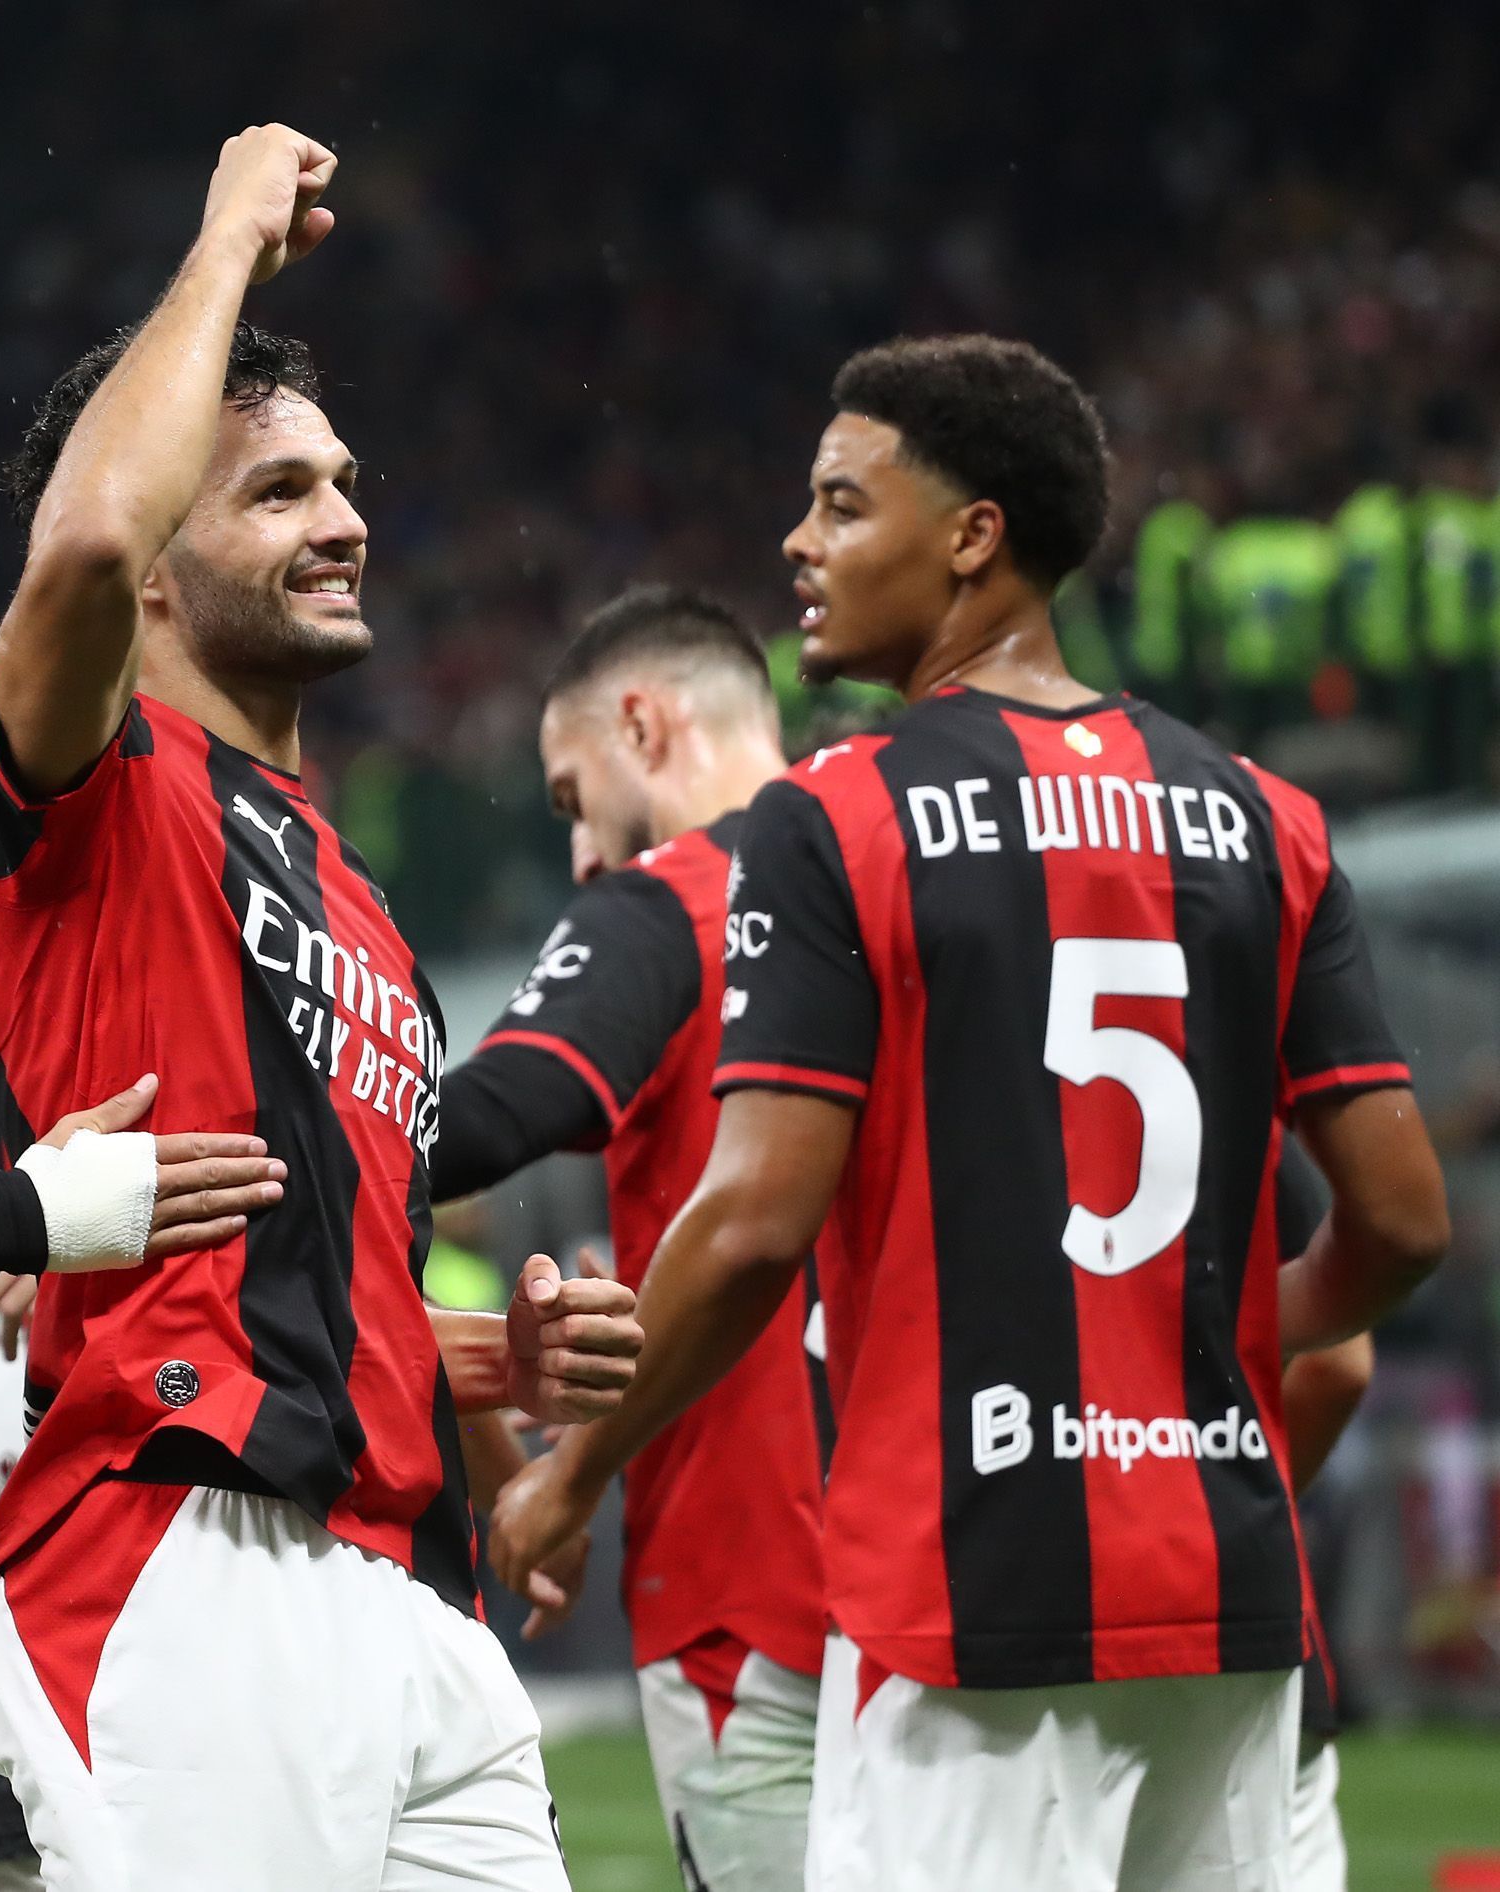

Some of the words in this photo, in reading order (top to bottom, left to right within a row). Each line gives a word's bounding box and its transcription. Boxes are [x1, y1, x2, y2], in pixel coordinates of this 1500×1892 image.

[906, 777, 1001, 858] DE
[1018, 774, 1250, 862] WINTER
[722, 911, 773, 959] SC
[351, 1037, 440, 1170] BETTER
[1044, 938, 1202, 1276] 5
[1052, 1403, 1268, 1473] bitpanda
